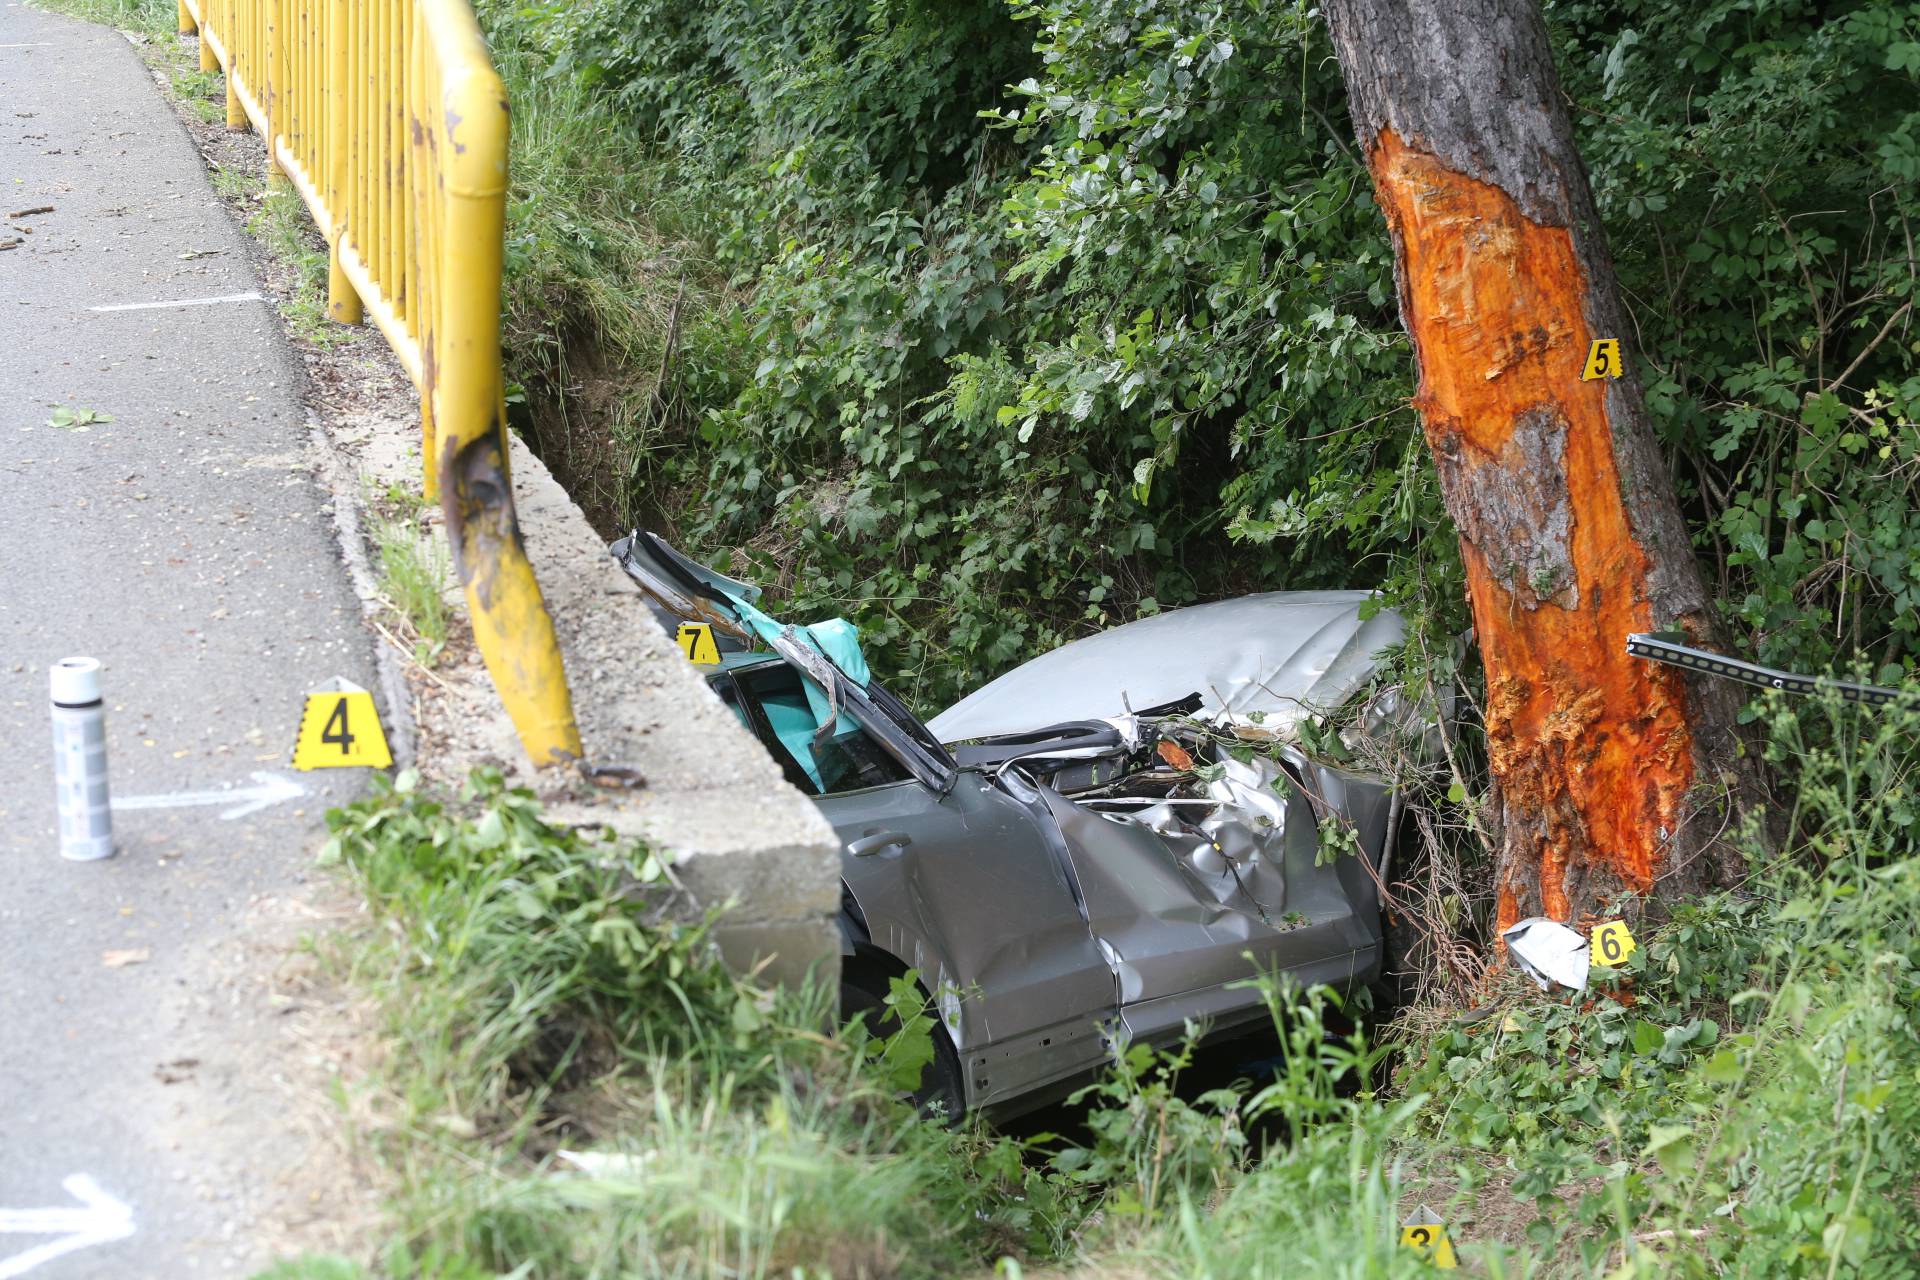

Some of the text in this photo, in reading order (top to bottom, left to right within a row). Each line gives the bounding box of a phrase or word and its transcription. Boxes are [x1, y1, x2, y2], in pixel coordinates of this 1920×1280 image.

[1594, 343, 1610, 375] 5
[684, 628, 701, 660] 7
[321, 697, 355, 755] 4
[1601, 928, 1621, 960] 6
